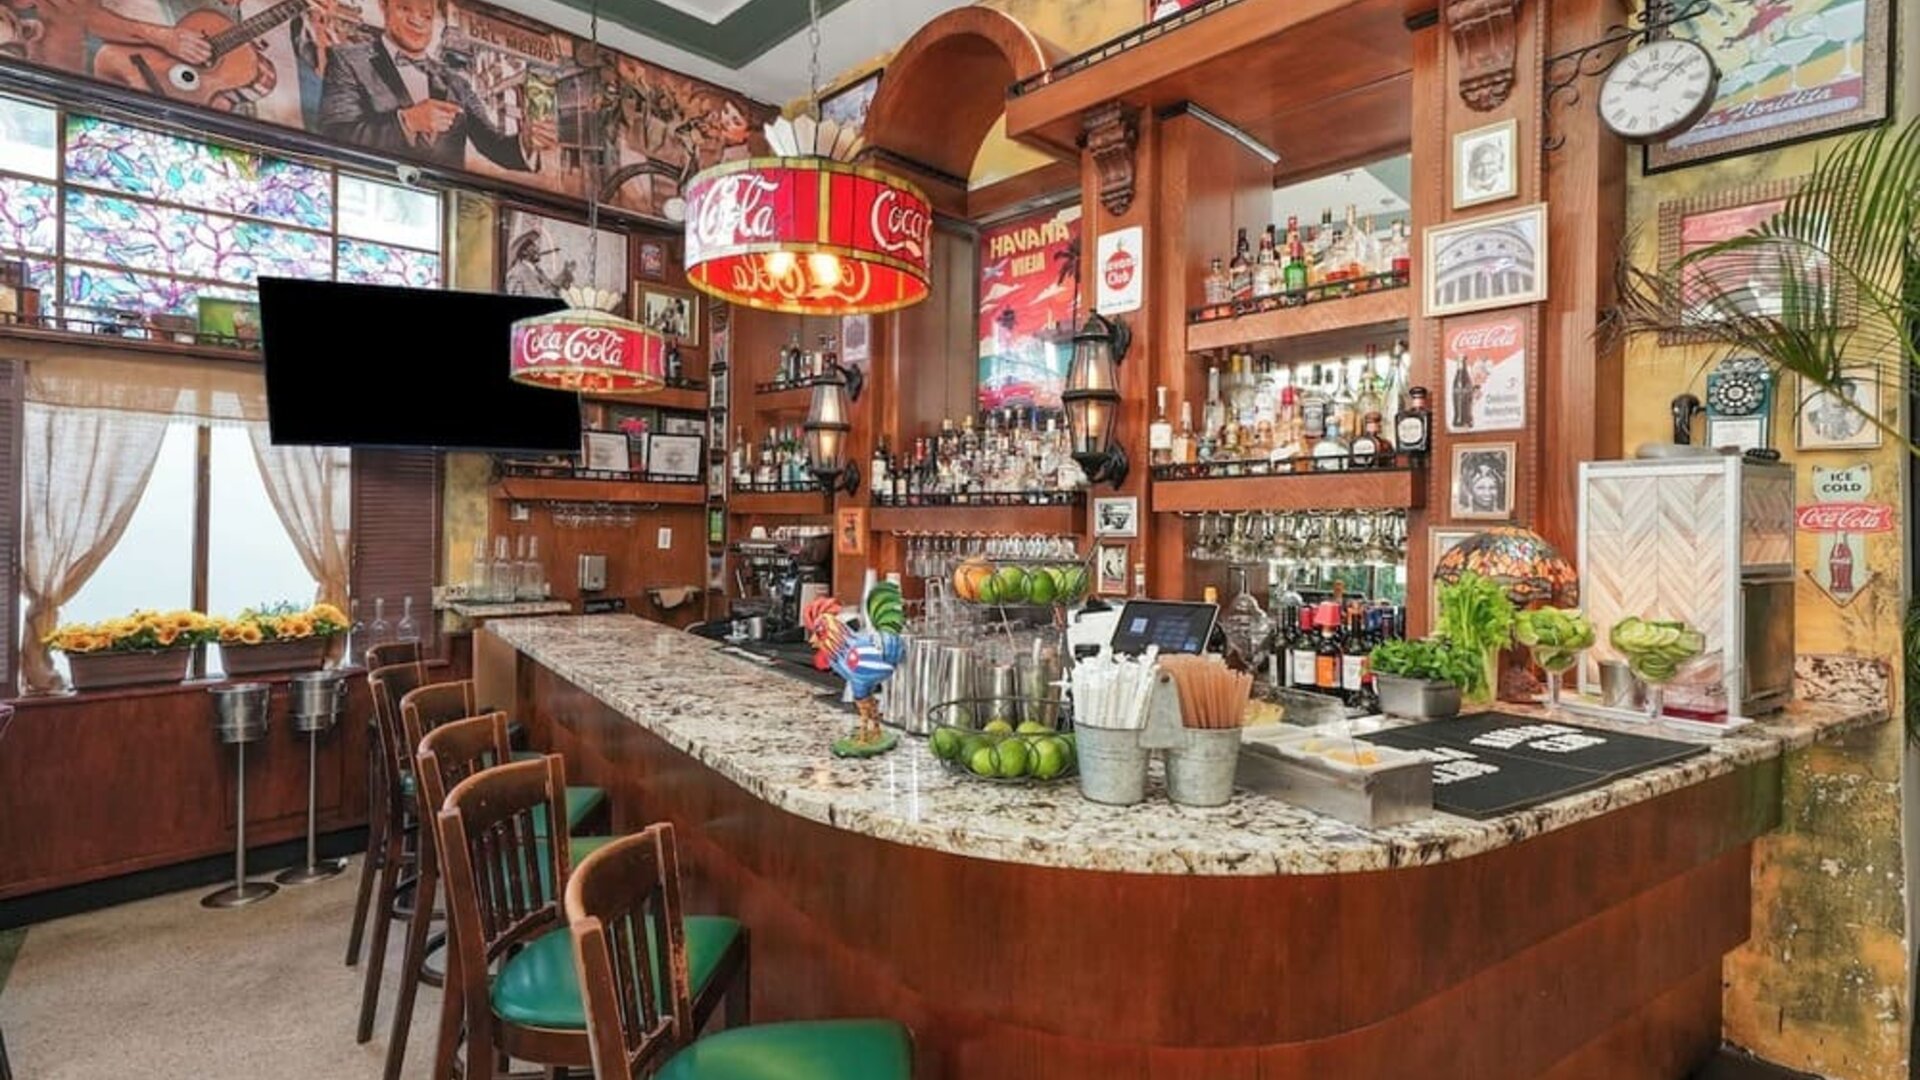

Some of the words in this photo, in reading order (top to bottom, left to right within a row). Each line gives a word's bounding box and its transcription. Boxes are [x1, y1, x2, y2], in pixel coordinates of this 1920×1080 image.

[870, 189, 923, 257] Coca
[990, 221, 1070, 259] HAVANA
[1822, 483, 1862, 493] COLD
[1831, 472, 1853, 481] ICE
